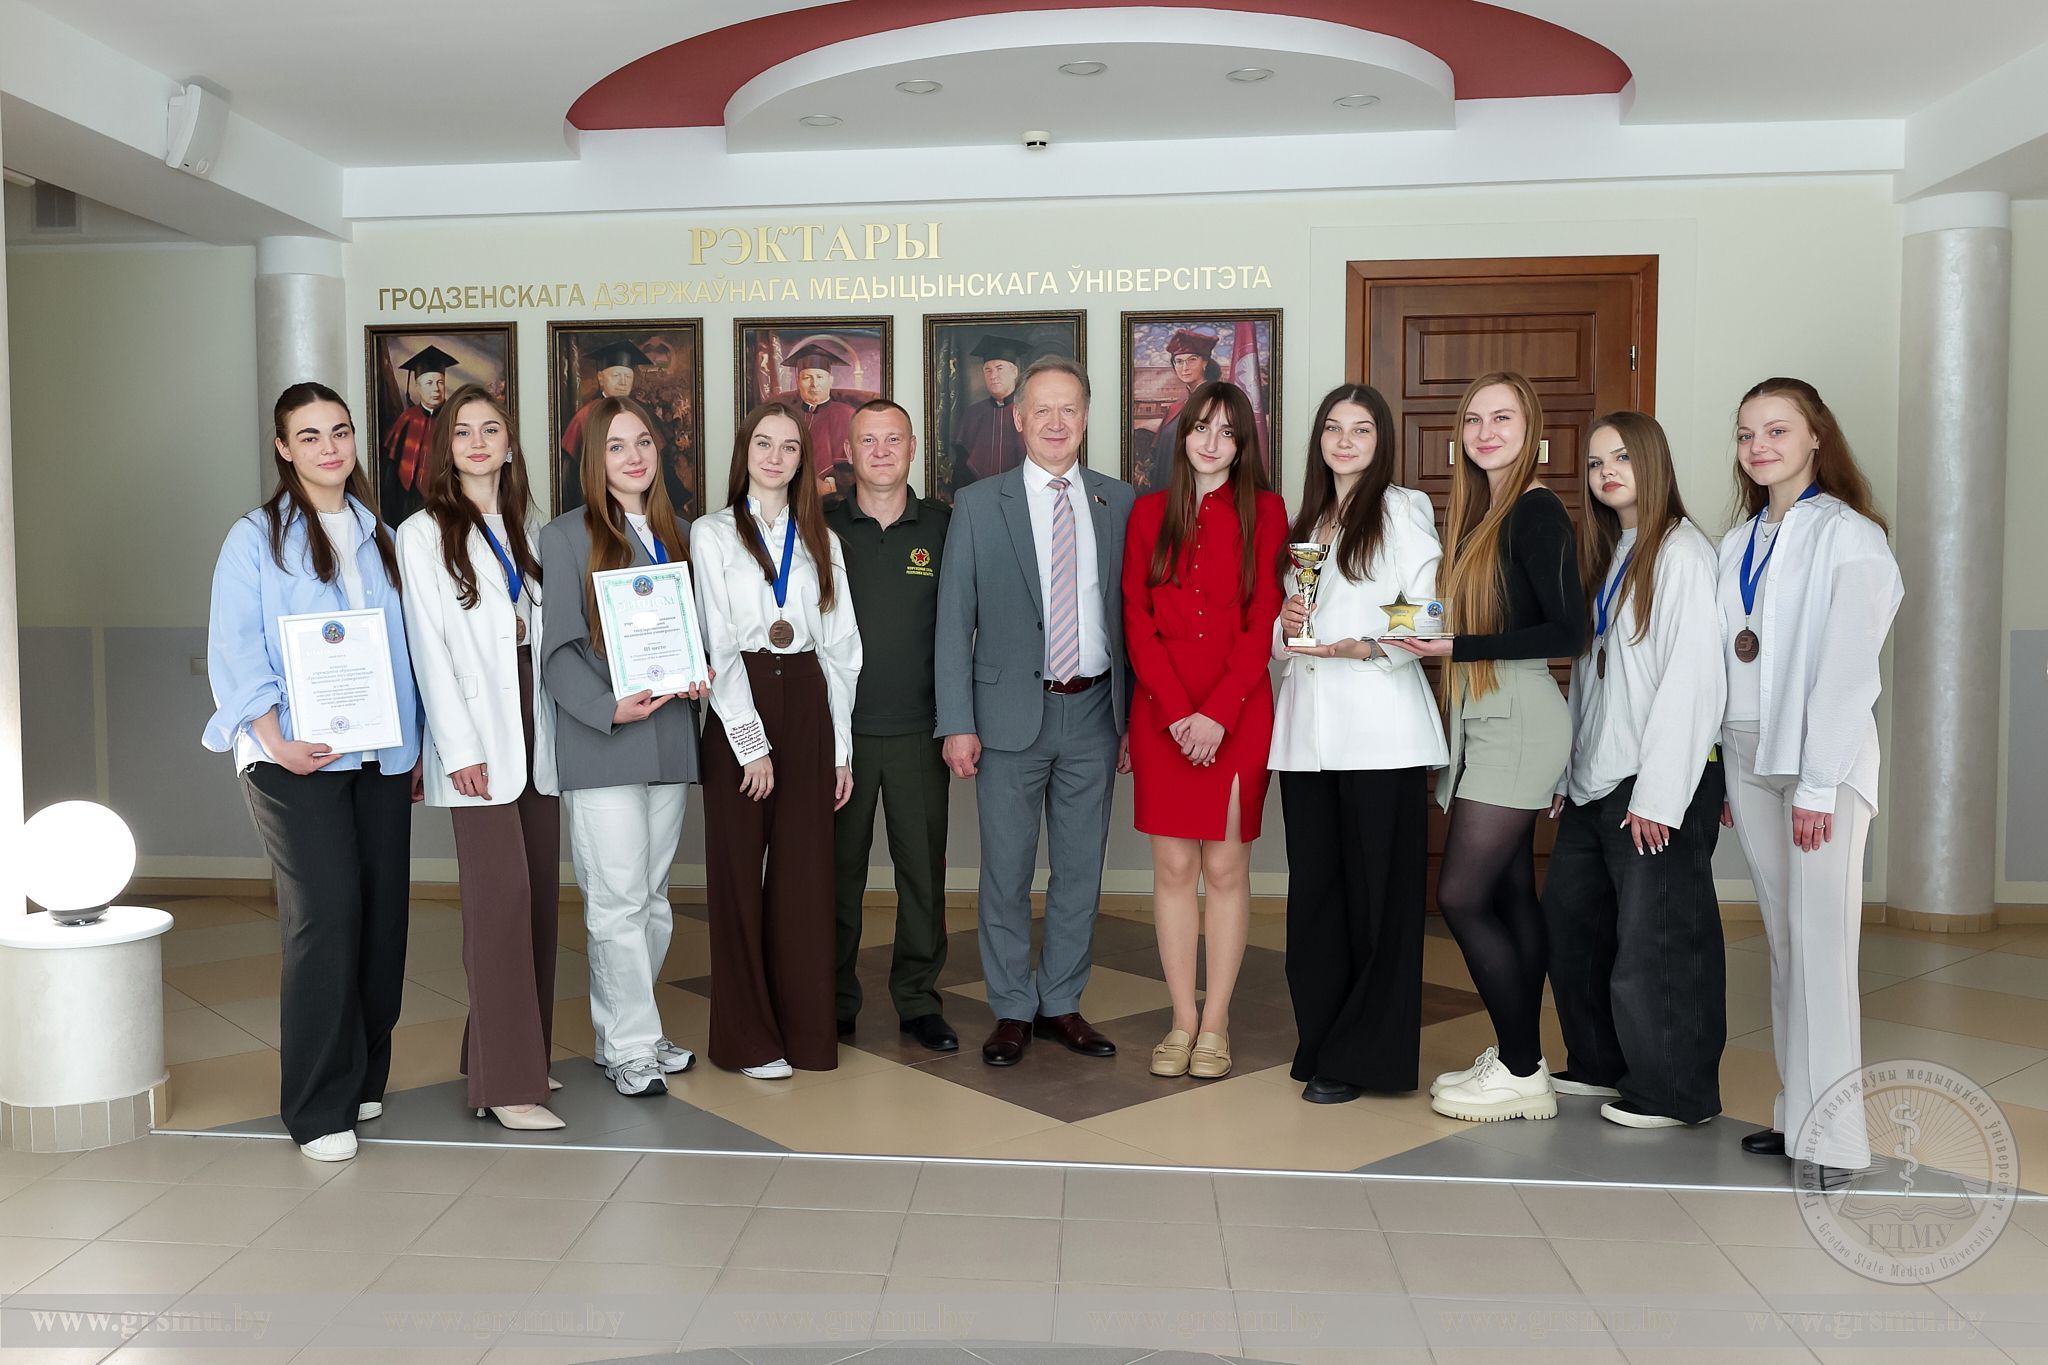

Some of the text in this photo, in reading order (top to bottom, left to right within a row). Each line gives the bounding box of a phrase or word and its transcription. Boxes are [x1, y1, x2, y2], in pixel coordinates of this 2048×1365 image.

[688, 222, 943, 265] РЭКТАРЫ
[379, 265, 1272, 313] ГРОДЗЕНСКАГА ДЗЯРЖАЎНАГА МЕДЫЦЫНСКАГА ЎНІВЕРСІТЭТА
